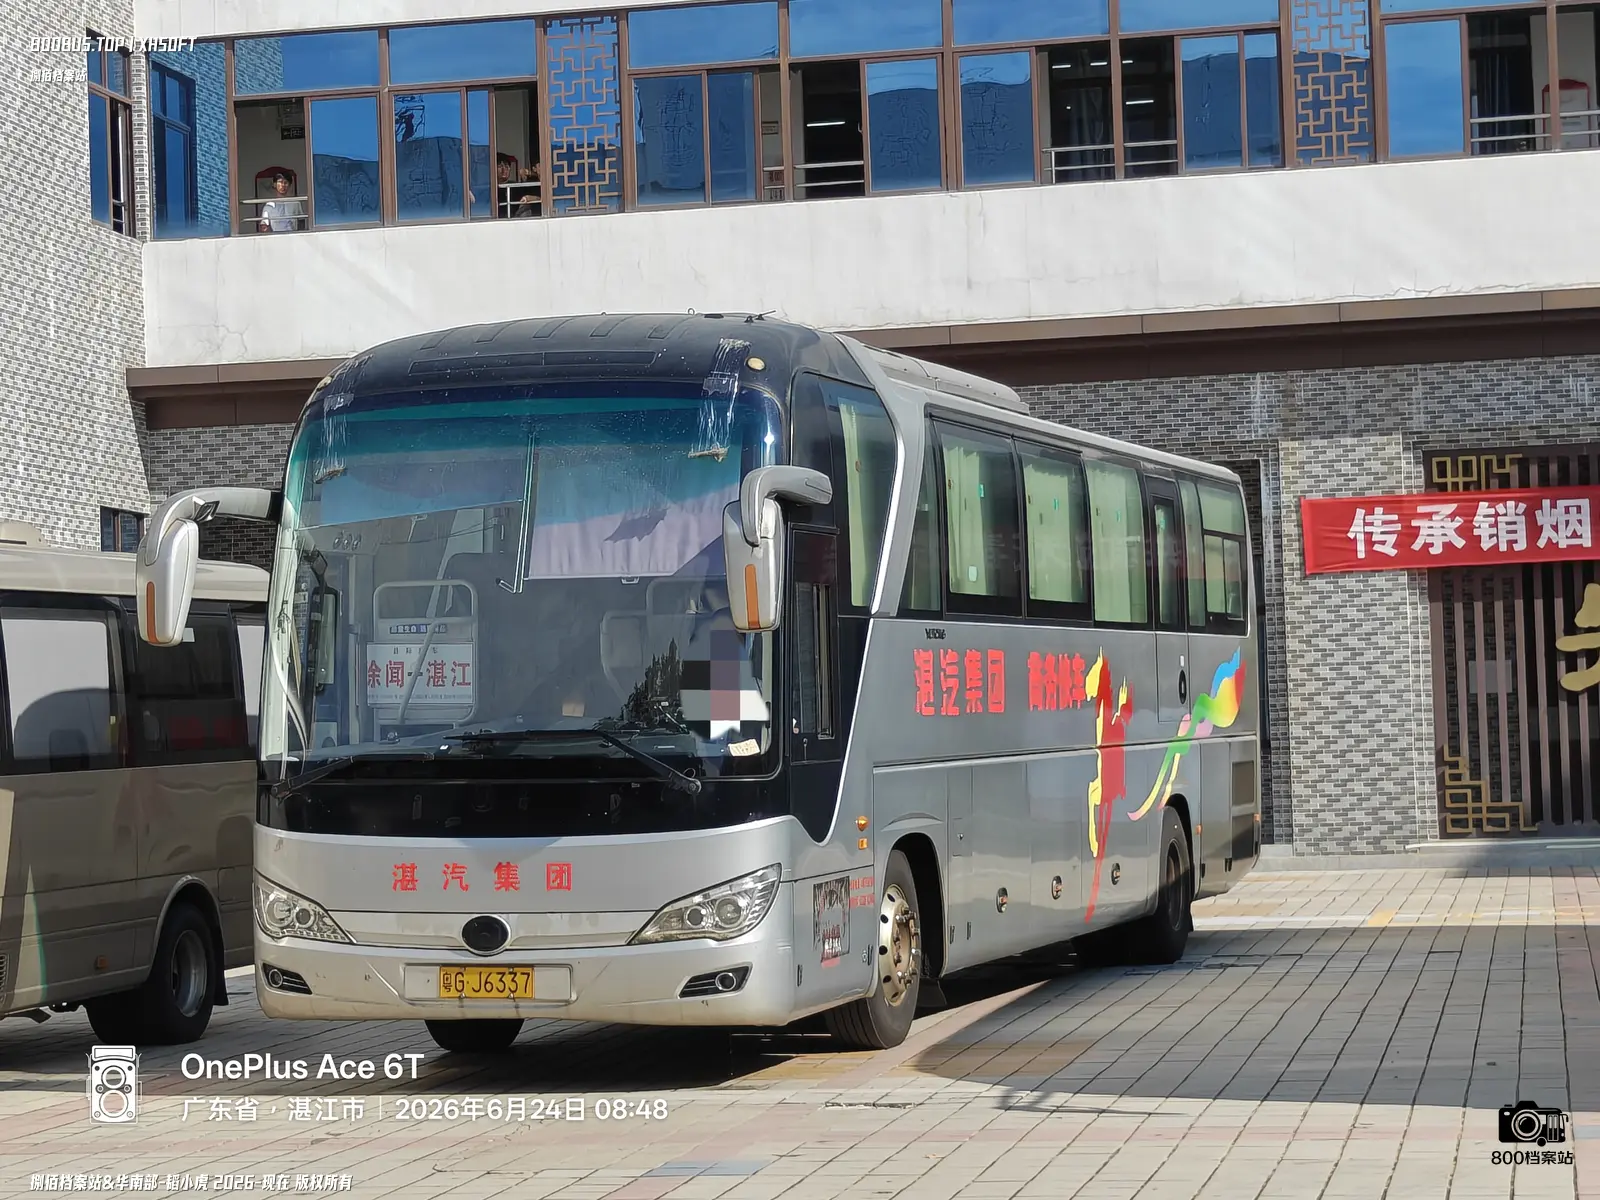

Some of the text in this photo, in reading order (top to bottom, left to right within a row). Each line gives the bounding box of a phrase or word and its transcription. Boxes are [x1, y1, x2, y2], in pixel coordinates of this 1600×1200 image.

[1347, 498, 1593, 559] 传承销烟
[392, 862, 573, 892] 湛汽集团
